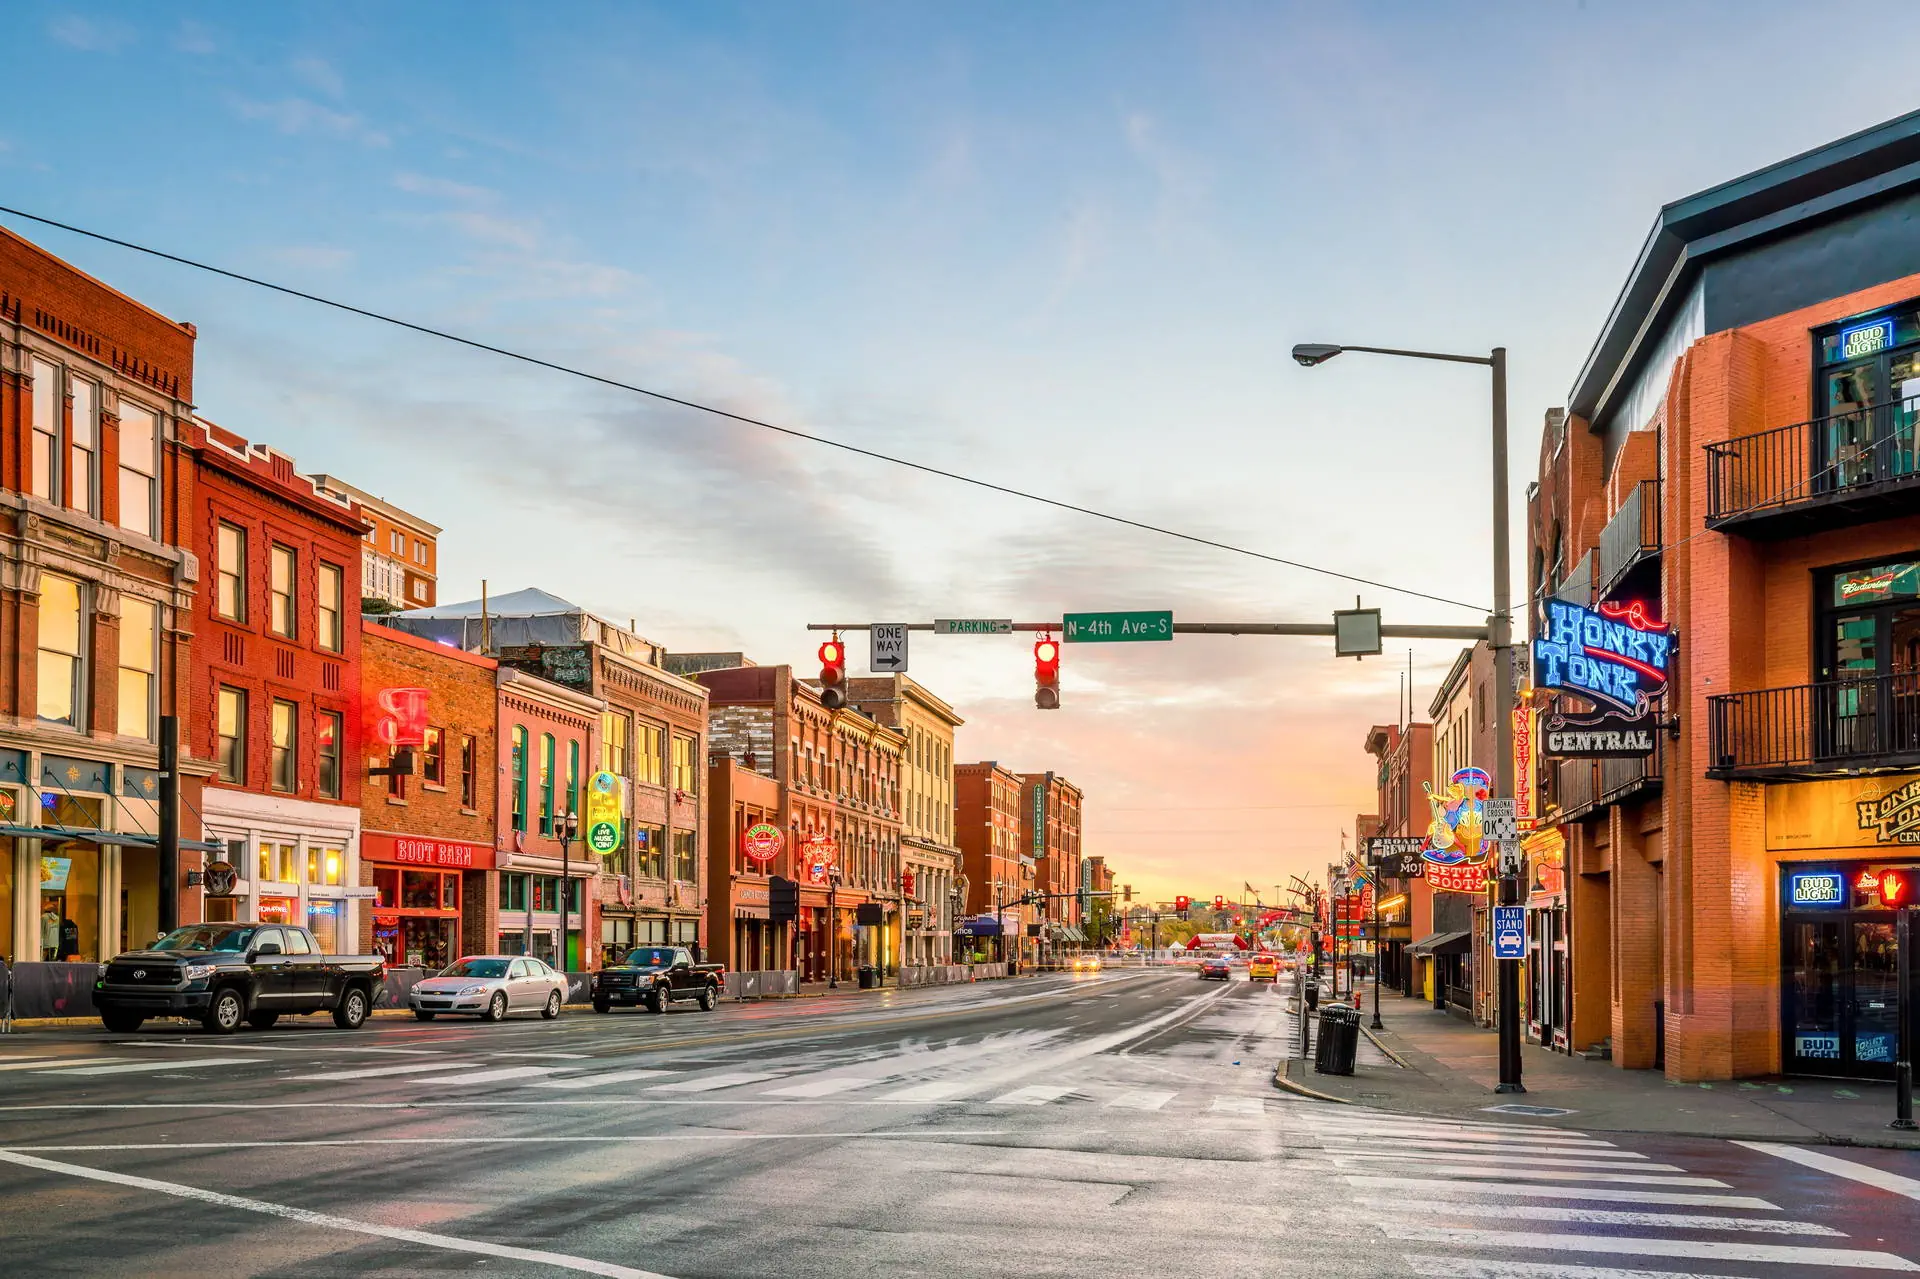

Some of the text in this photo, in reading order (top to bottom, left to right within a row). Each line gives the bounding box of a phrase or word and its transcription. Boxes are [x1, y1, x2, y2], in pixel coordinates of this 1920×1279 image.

[1851, 326, 1883, 345] BUD
[1845, 336, 1889, 358] LIGHT
[877, 627, 902, 639] ONE
[949, 621, 997, 633] PARKING
[1068, 618, 1167, 635] N-4th Ave-S
[1551, 603, 1668, 668] HONKY
[876, 641, 902, 651] WAY
[1537, 640, 1637, 706] TONK
[1548, 730, 1653, 751] CENTRAL
[1517, 708, 1529, 817] NASHVILLE
[1486, 800, 1514, 809] DIAGONAL
[1487, 809, 1514, 817] CROSSING
[1484, 819, 1497, 835] OK
[397, 839, 472, 866] BOOT BARN
[596, 841, 613, 849] JOINT
[747, 842, 761, 857] CANDY
[761, 842, 779, 858] KITCHEN
[1428, 863, 1483, 878] BETTY
[1429, 875, 1483, 890] BOOTS
[1801, 877, 1833, 889] BUD
[1796, 888, 1838, 900] LIGHT
[1501, 908, 1519, 918] TAXI
[1496, 919, 1523, 929] STAND
[1802, 1039, 1835, 1050] BUD
